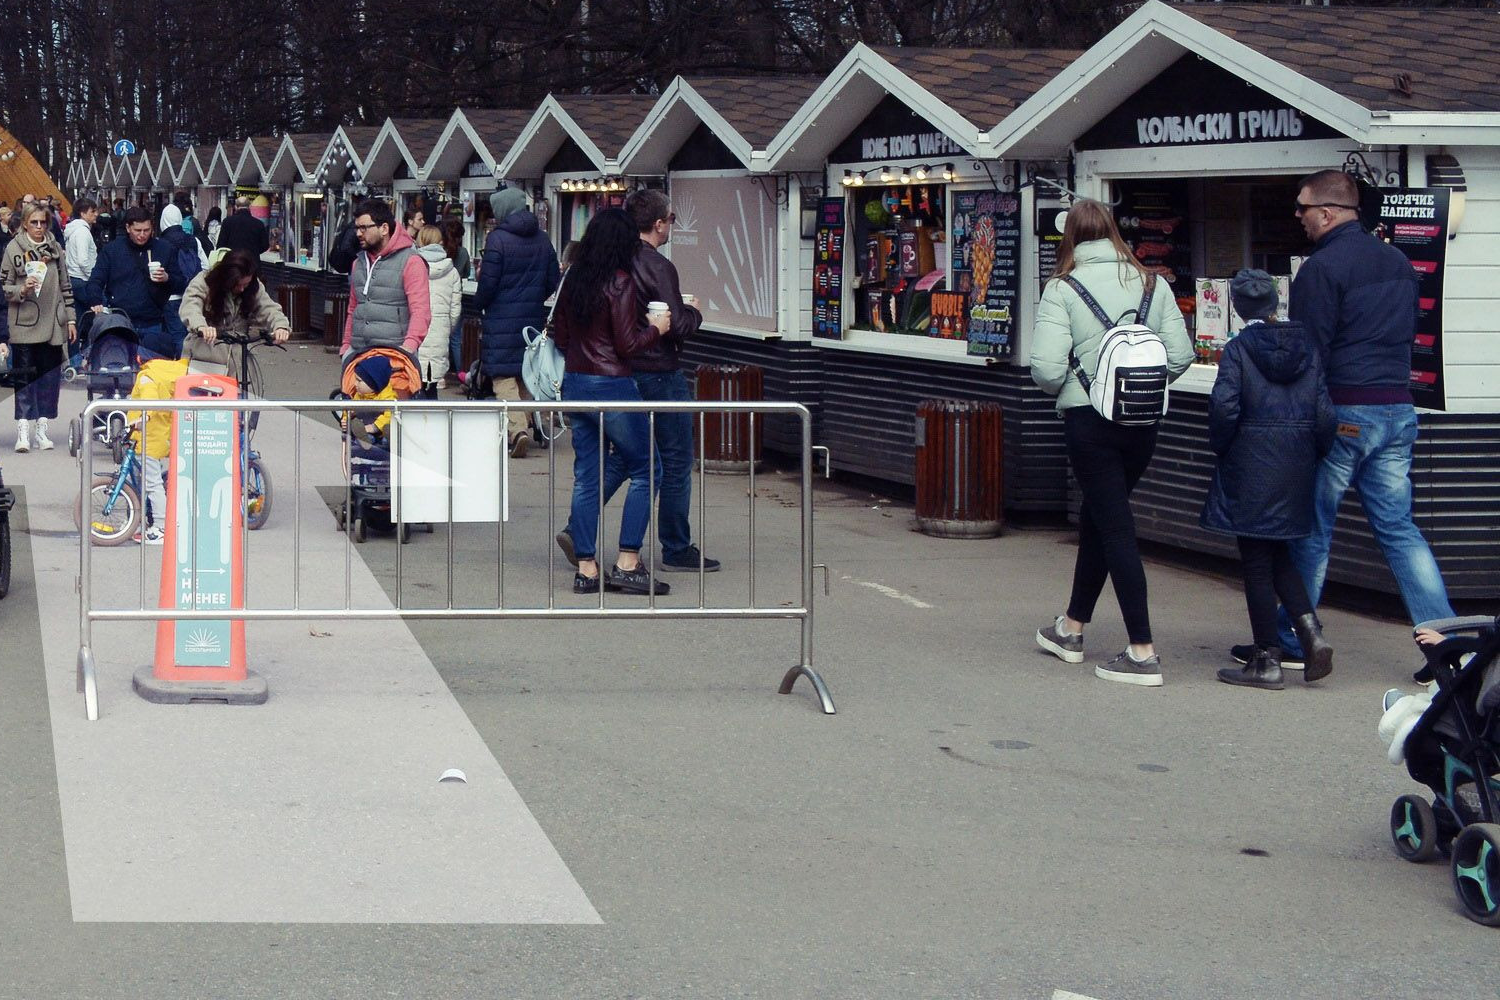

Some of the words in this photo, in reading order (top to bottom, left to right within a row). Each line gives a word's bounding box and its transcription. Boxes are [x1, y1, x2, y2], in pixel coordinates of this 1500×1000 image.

[1136, 112, 1232, 144] КОЛБАСКИ
[1238, 108, 1304, 139] ГРИЛЬ
[862, 137, 888, 159] HONG
[889, 134, 916, 158] KONG
[1383, 194, 1434, 206] ГОРЯЧИЕ
[1380, 206, 1435, 218] НАПИТКИ
[931, 293, 964, 316] BUBBLE
[181, 593, 226, 604] МЕНЕЕ
